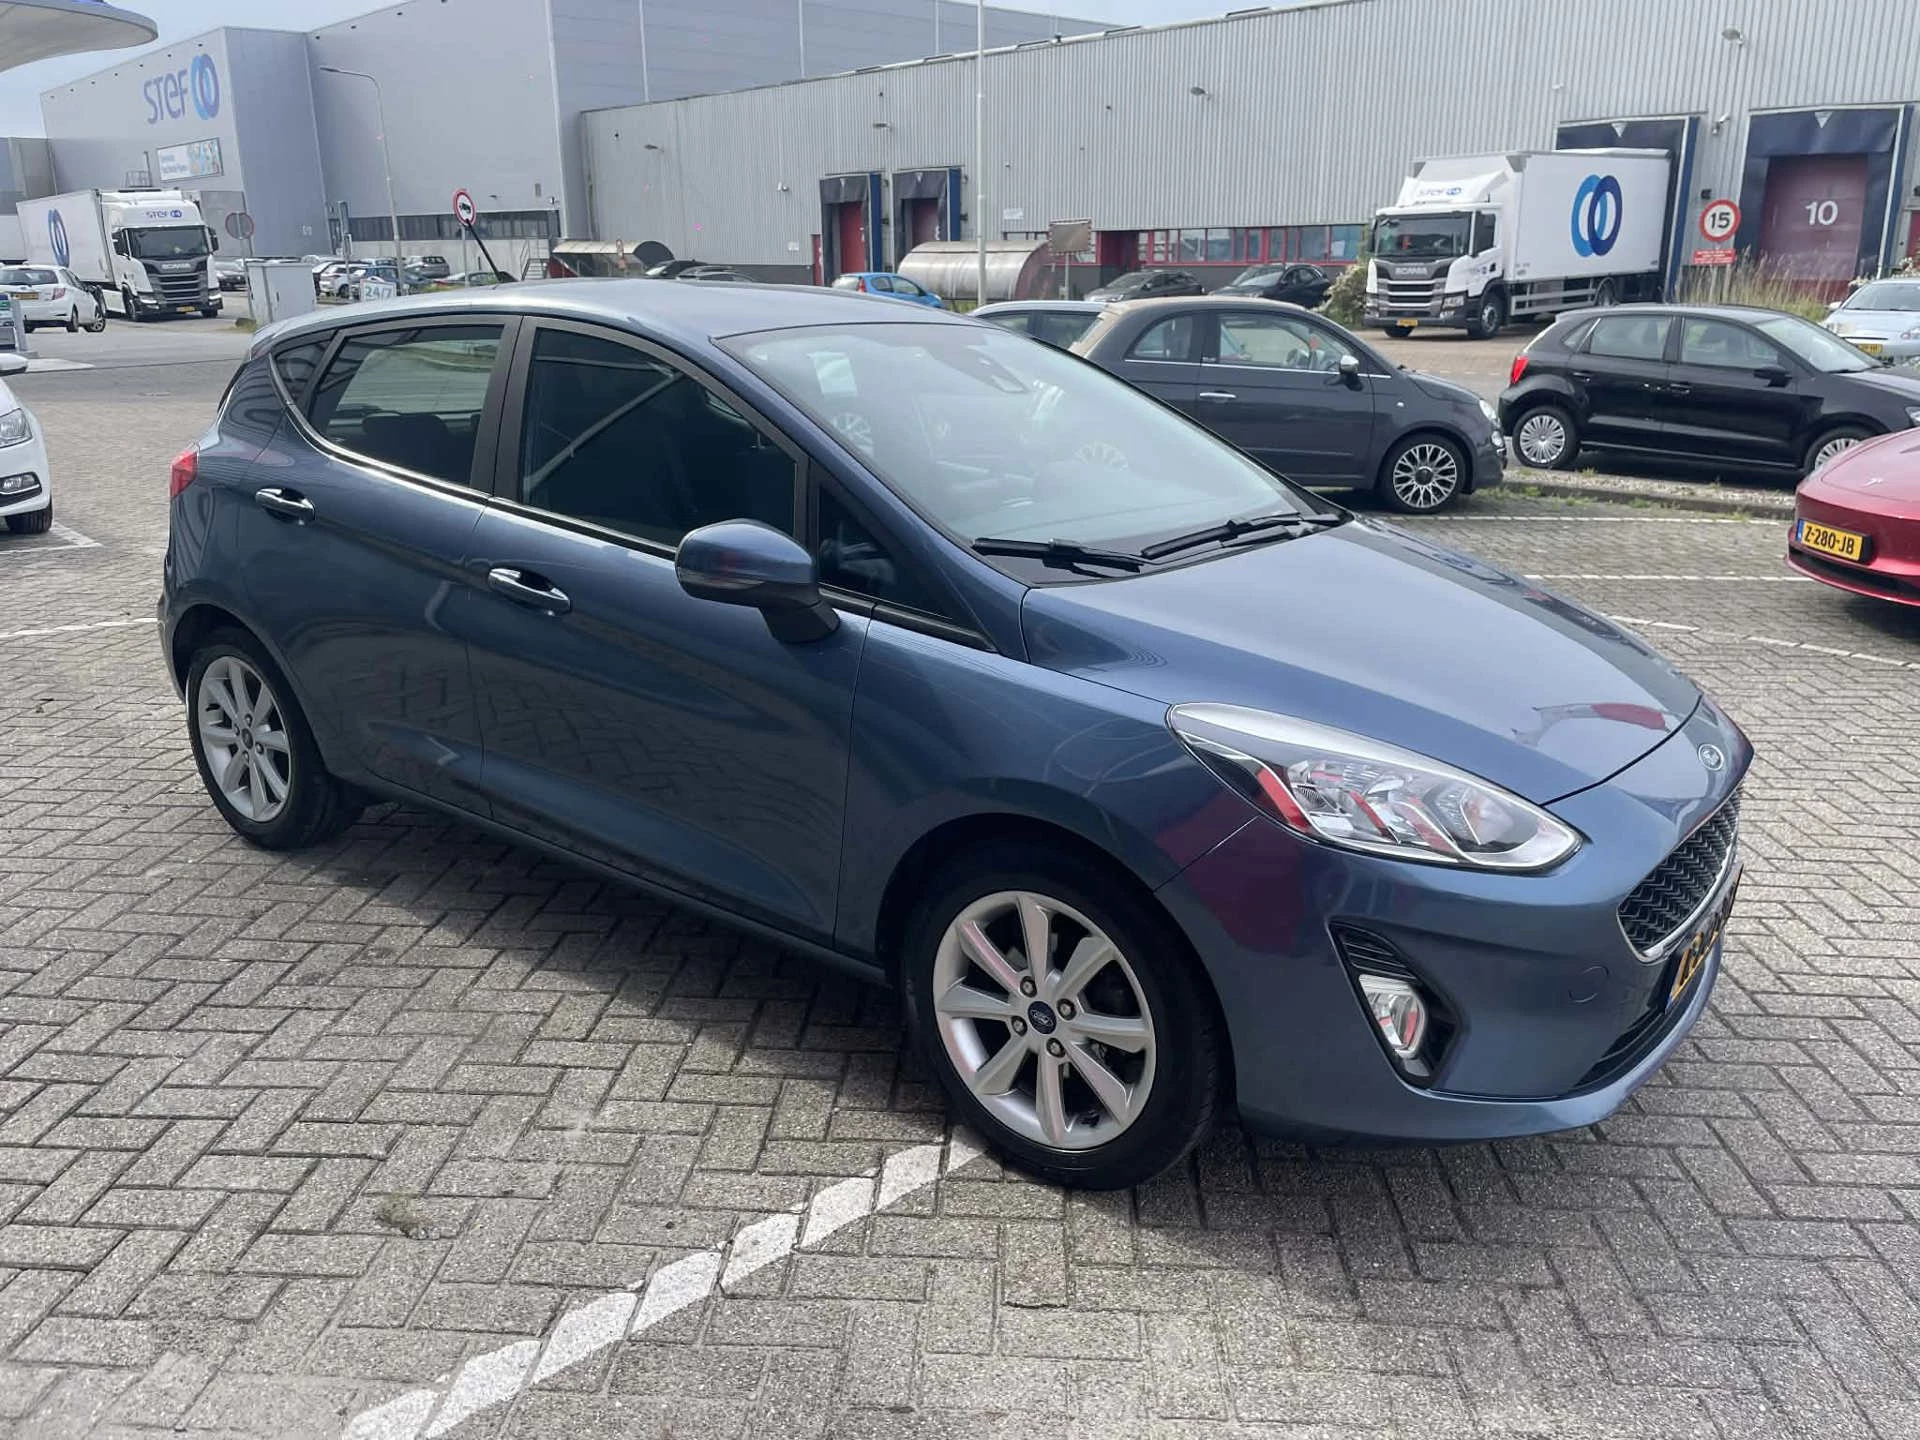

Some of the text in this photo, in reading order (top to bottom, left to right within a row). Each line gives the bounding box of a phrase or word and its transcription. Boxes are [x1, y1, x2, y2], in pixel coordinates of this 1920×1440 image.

[1709, 211, 1731, 230] 15
[1806, 200, 1839, 226] 10
[1804, 524, 1856, 556] Z-280-JB
